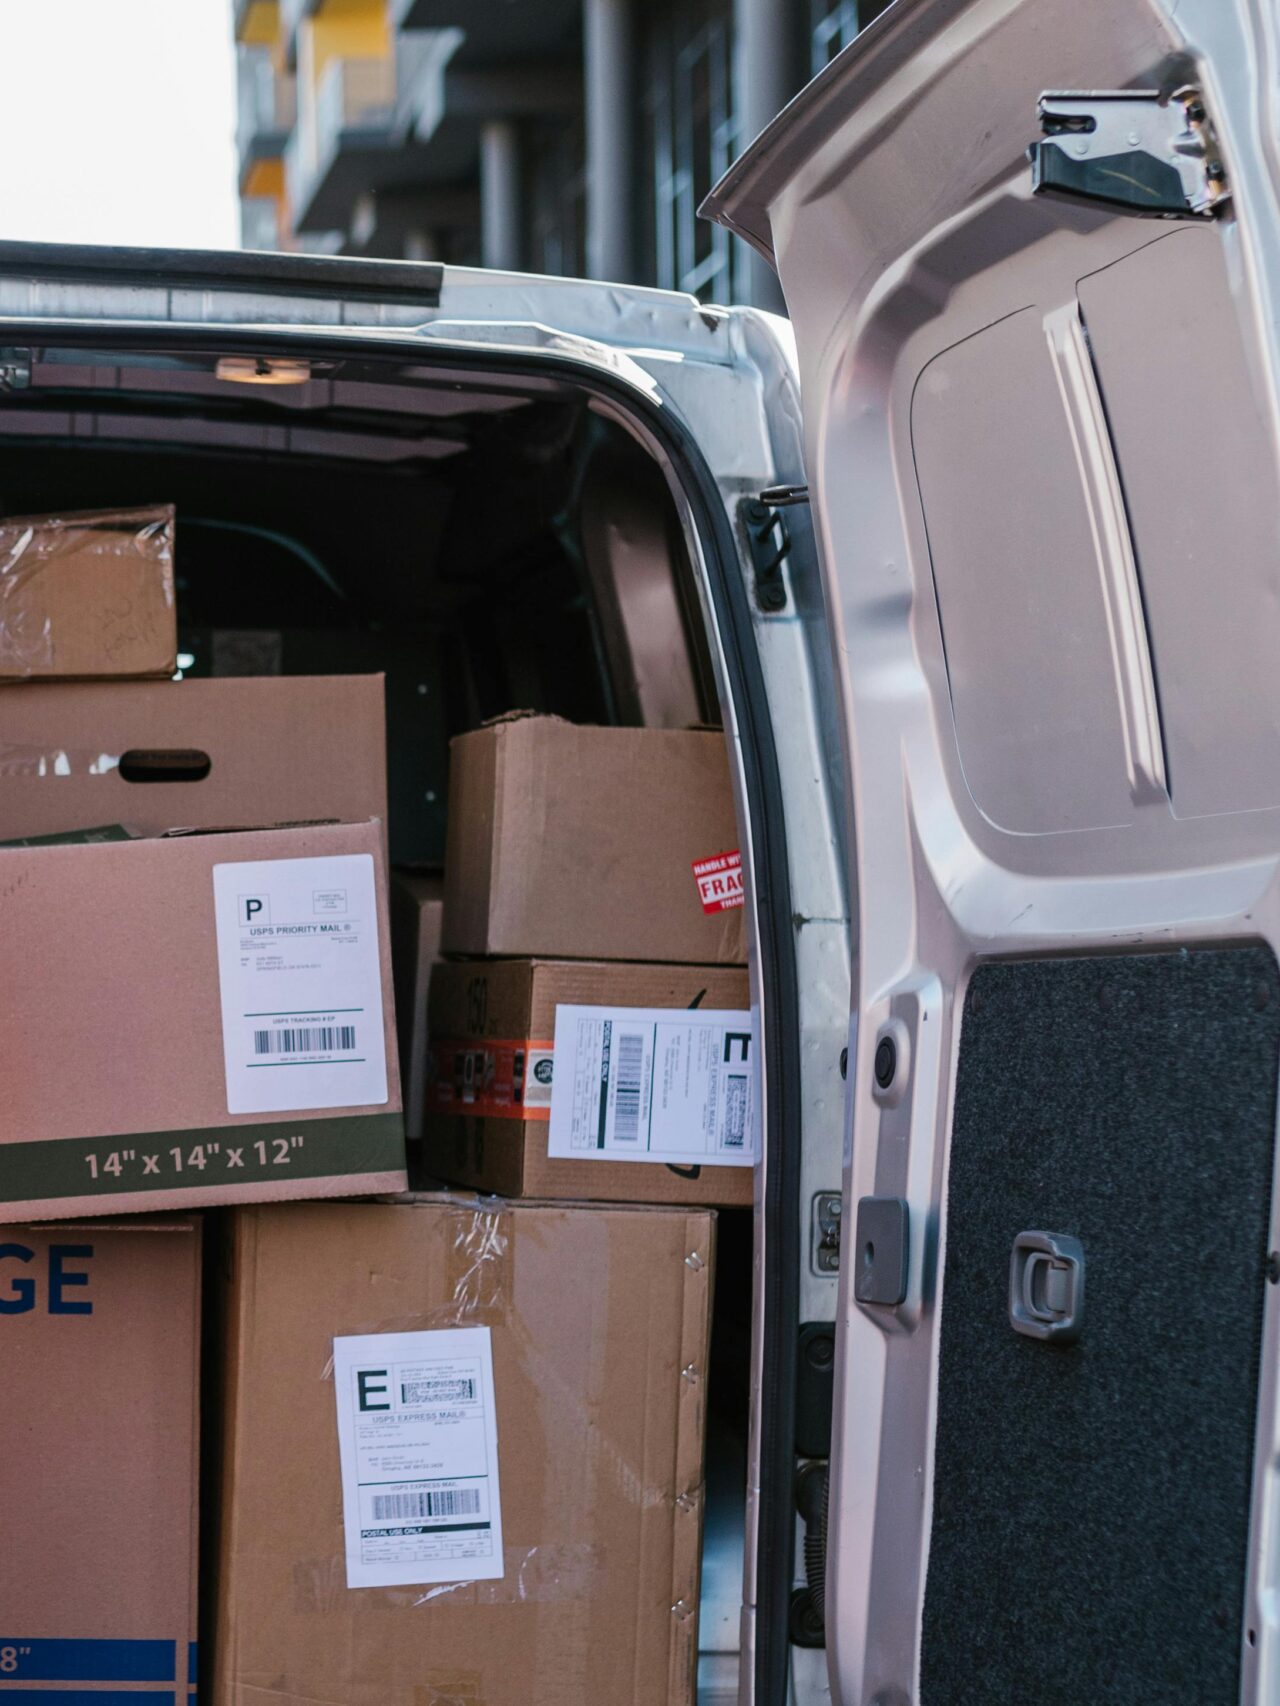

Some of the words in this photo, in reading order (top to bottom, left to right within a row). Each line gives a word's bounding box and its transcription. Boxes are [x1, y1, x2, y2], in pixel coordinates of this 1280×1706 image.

[694, 857, 727, 876] HANDLE
[246, 899, 262, 921] P
[250, 927, 275, 936] USPS
[276, 925, 318, 935] PRIORITY
[320, 924, 342, 933] MAIL
[85, 1150, 135, 1179] 14"
[142, 1154, 161, 1175] x
[169, 1143, 220, 1172] 14"
[226, 1147, 245, 1168] x
[253, 1136, 304, 1165] 12"
[357, 1370, 390, 1412] E
[372, 1415, 395, 1424] USPS
[397, 1413, 437, 1422] EXPRESS
[362, 1528, 389, 1537] POSTAL
[389, 1528, 403, 1536] USE
[404, 1527, 423, 1535] ONLY
